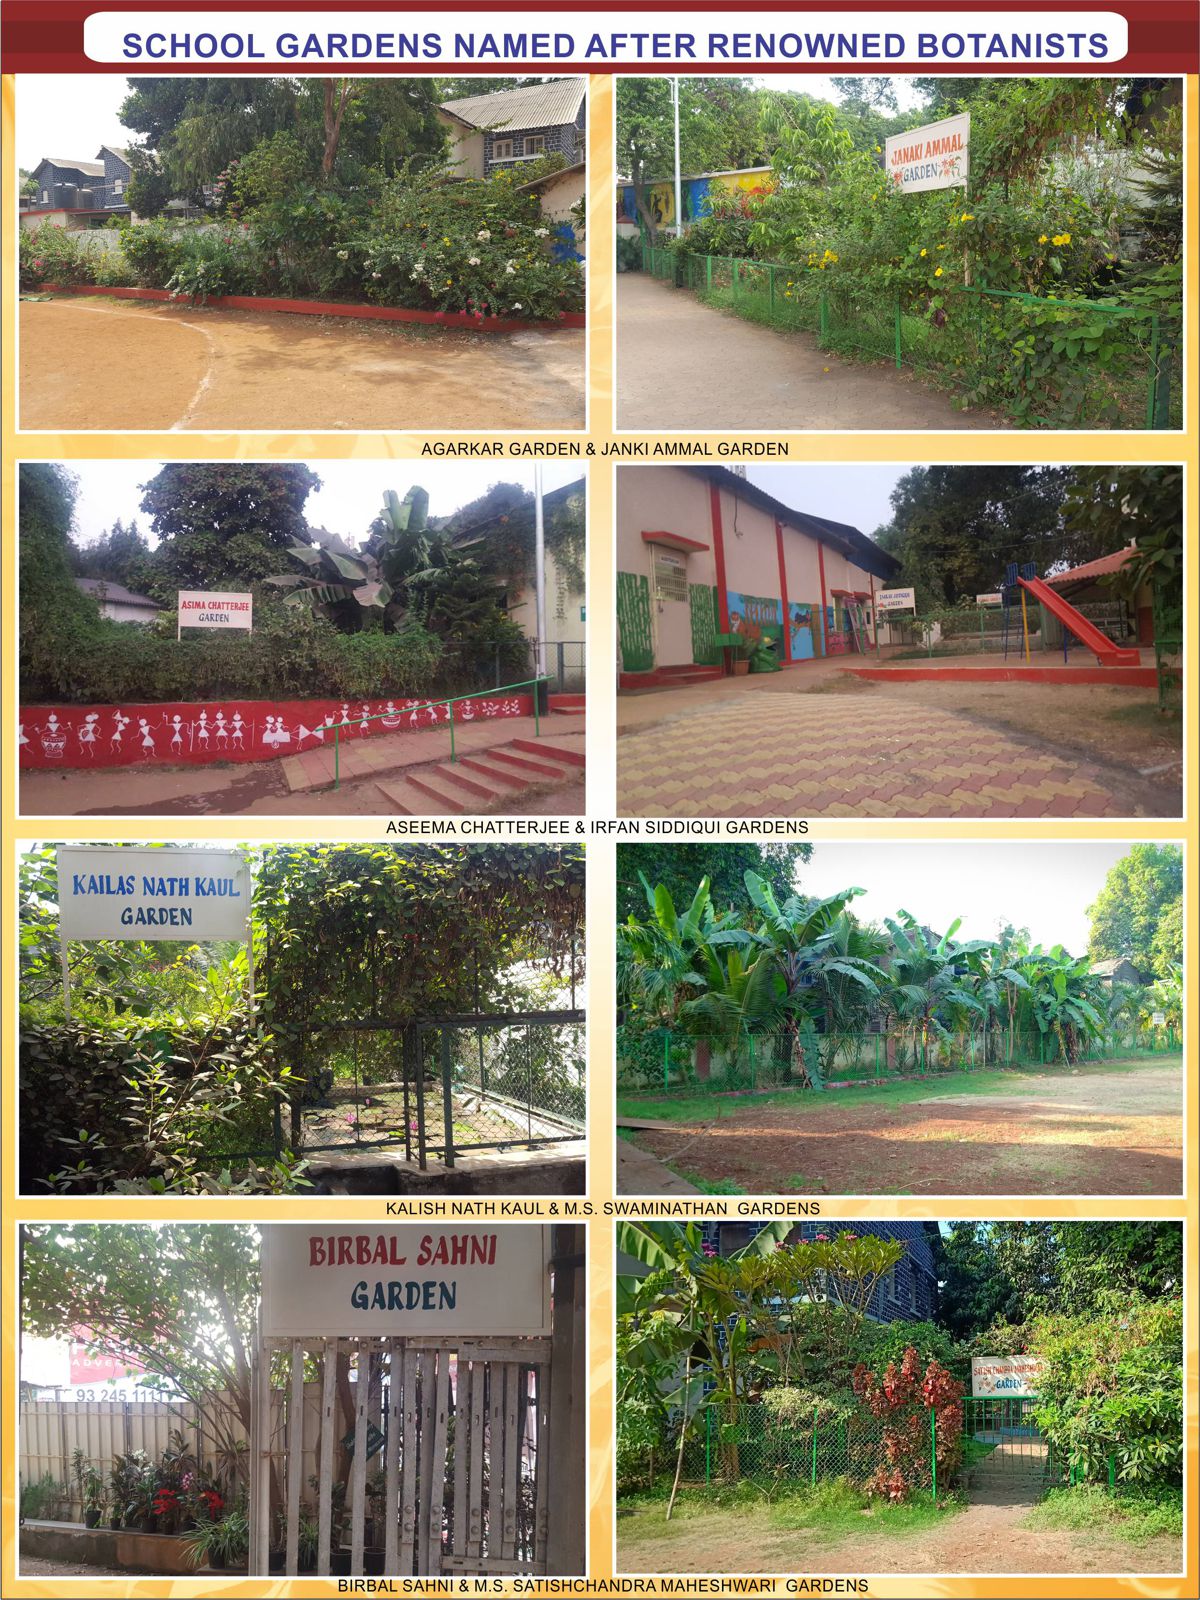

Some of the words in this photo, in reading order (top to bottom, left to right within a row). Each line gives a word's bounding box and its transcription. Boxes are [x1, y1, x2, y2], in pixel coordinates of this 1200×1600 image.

[891, 143, 923, 165] JANAKI
[924, 133, 964, 158] AMMAL
[903, 162, 938, 182] GARDEN
[181, 600, 206, 610] ASIMA
[207, 601, 250, 611] CHATTERJEE
[198, 613, 230, 623] GARDEN
[73, 874, 136, 895] KAILAS
[142, 876, 191, 896] NATH
[194, 877, 241, 897] KAUL
[120, 906, 193, 926] GARDEN
[309, 1235, 407, 1267] BIRBAL
[416, 1234, 498, 1266] SAHNI
[350, 1280, 457, 1311] GARDEN
[996, 1379, 1022, 1389] GARDEN
[76, 1389, 95, 1402] 93
[100, 1389, 127, 1402] 245
